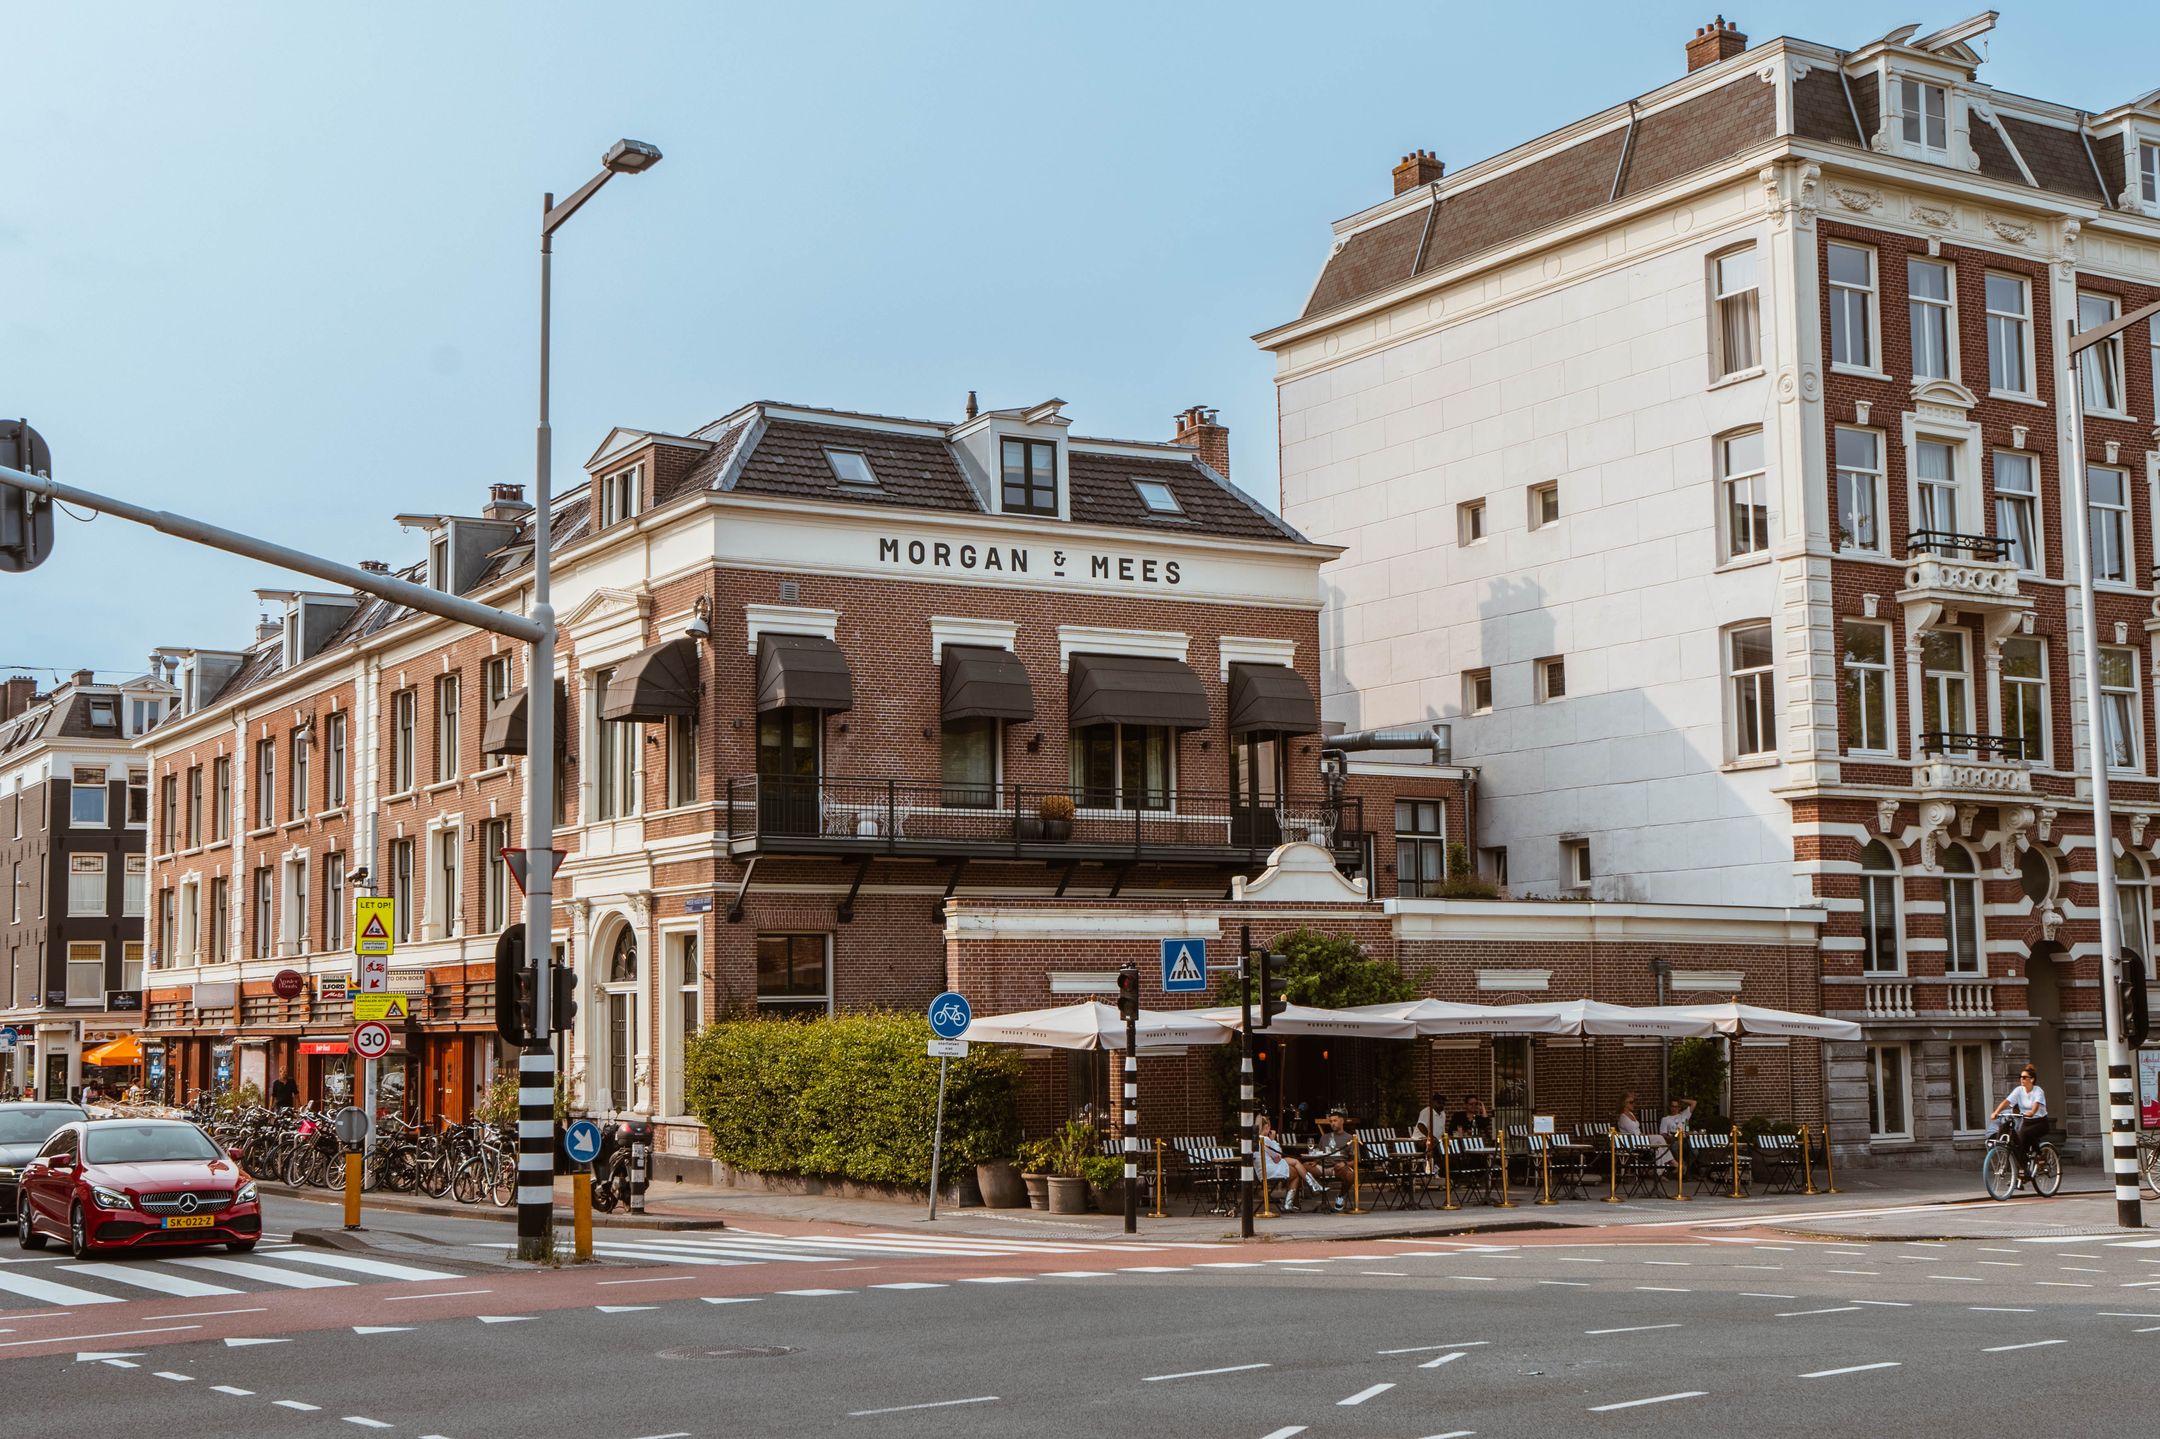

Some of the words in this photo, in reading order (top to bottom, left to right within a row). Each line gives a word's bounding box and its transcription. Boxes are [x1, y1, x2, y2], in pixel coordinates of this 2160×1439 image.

[879, 537, 1028, 573] MORGAN
[1053, 550, 1066, 577] &
[1091, 555, 1181, 584] MEES
[360, 901, 375, 909] LET
[360, 1032, 385, 1047] 30
[170, 1216, 212, 1227] SK-022-Z
